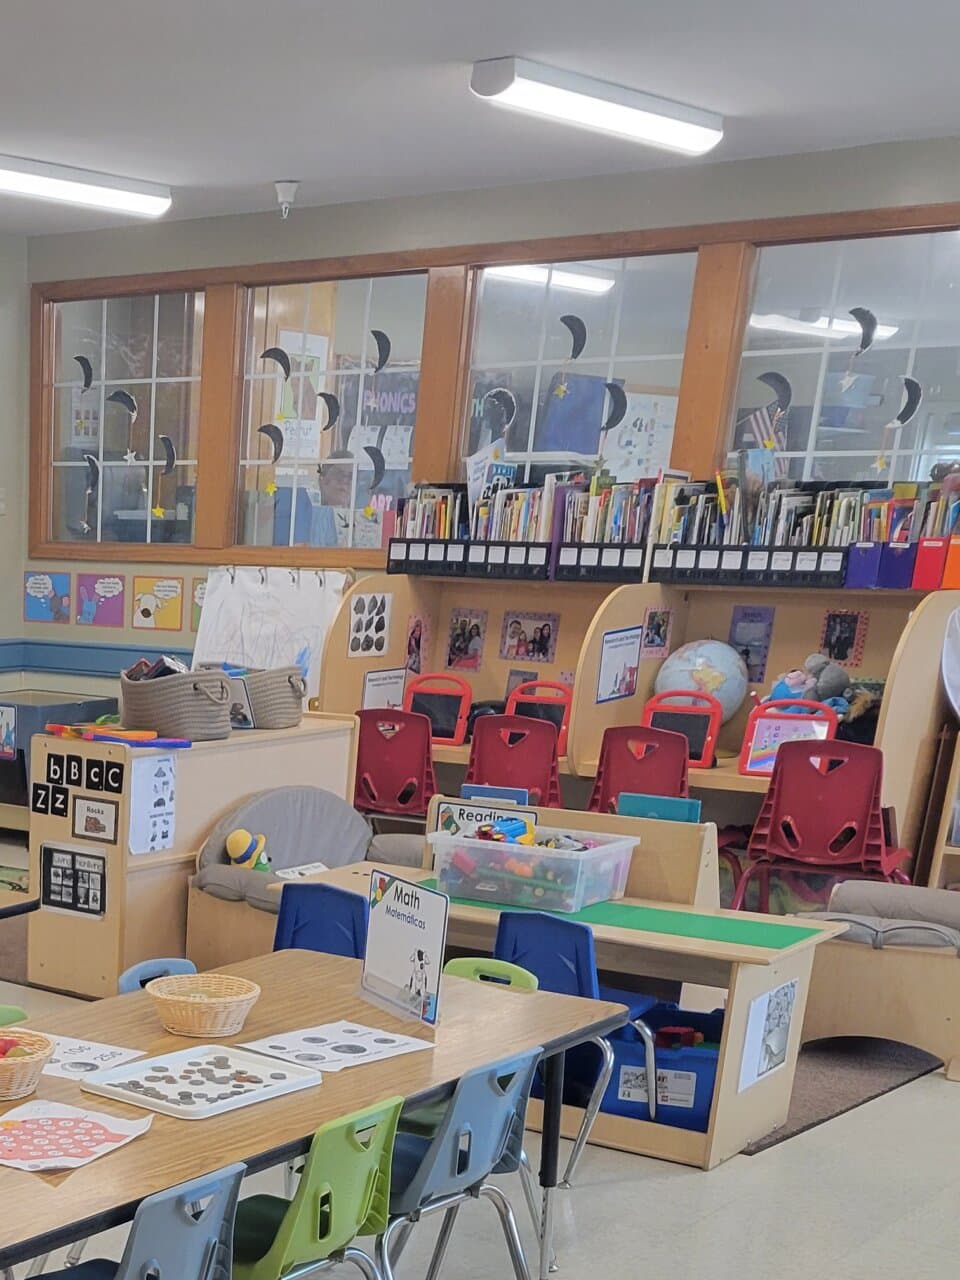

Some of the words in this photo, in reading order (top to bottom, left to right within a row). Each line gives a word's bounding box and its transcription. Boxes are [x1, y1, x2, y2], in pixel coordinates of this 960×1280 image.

[363, 390, 417, 415] PHONICS
[50, 757, 61, 779] b
[70, 761, 80, 780] B
[90, 767, 100, 783] c
[108, 767, 121, 788] C
[36, 789, 46, 809] Z
[54, 794, 65, 808] z
[458, 808, 505, 823] Readin
[393, 884, 421, 911] Math
[385, 905, 427, 931] Matemáticas
